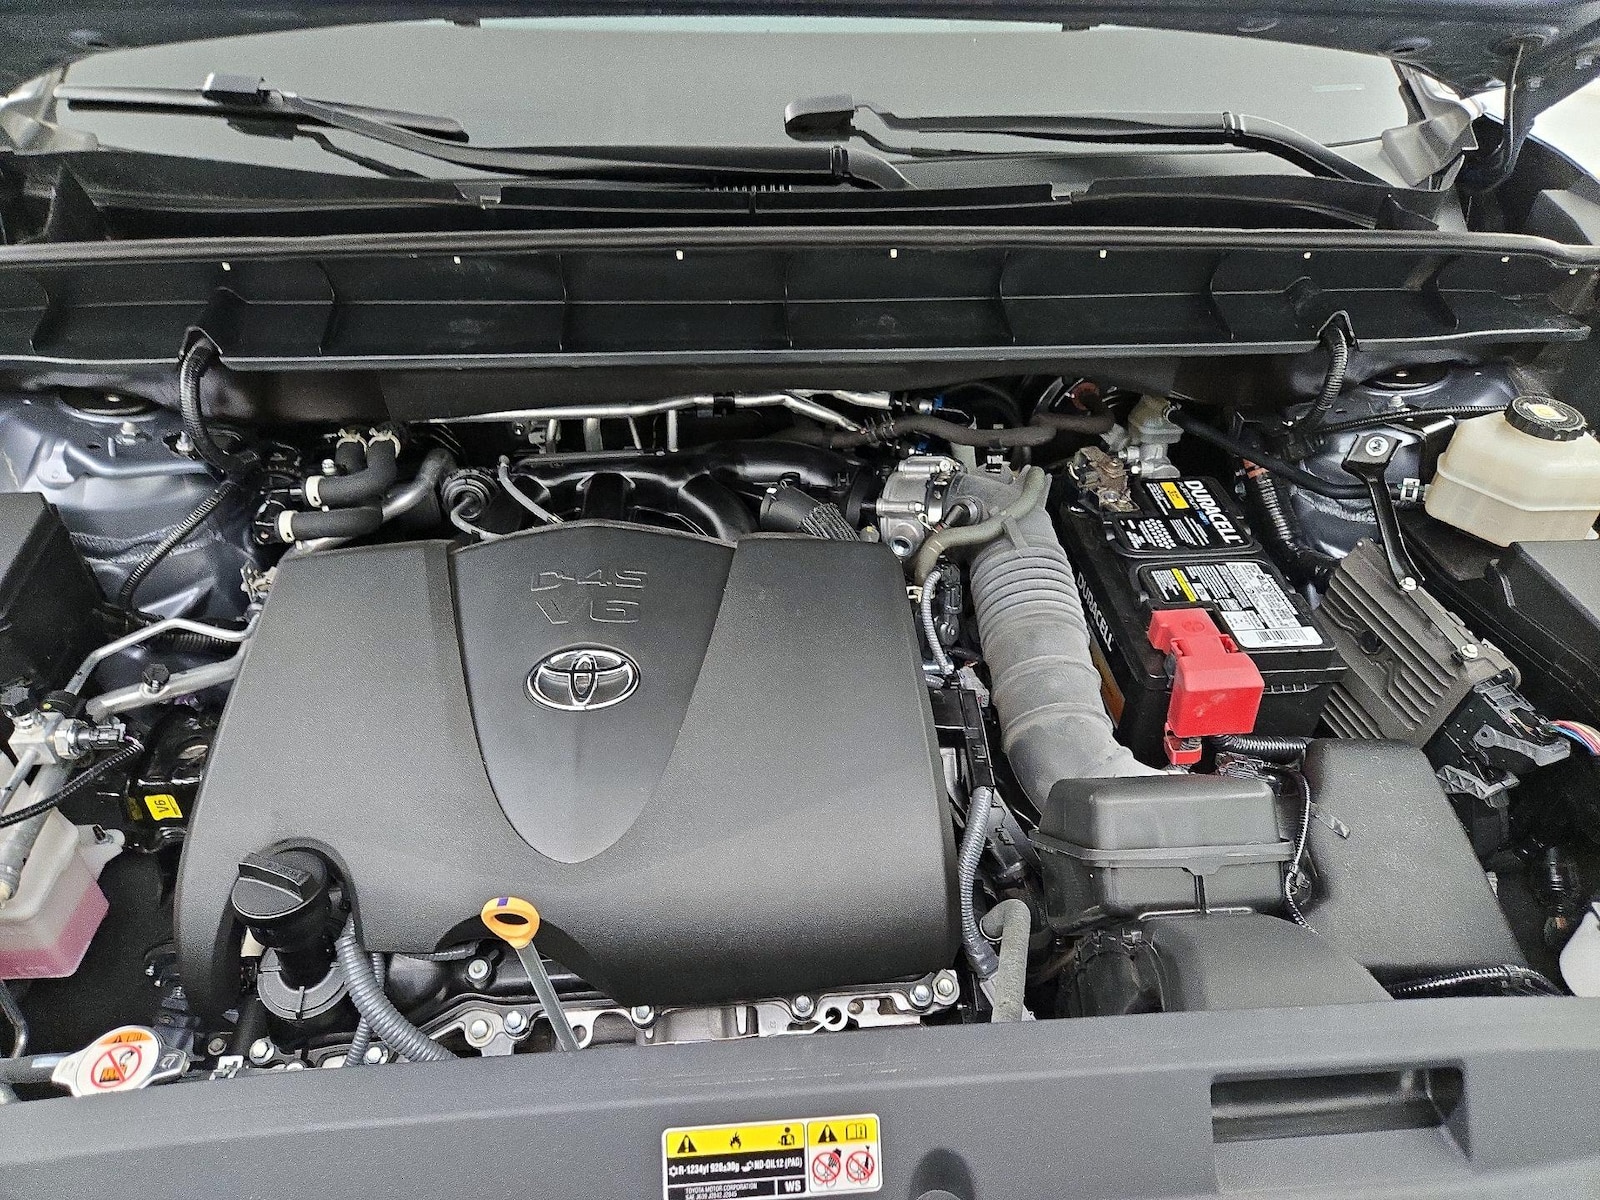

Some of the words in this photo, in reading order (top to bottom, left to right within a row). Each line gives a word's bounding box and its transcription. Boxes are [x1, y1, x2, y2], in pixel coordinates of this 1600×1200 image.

[1183, 480, 1242, 544] DURACELL
[530, 568, 648, 592] D-4S
[534, 599, 640, 625] V6
[1077, 571, 1113, 652] DURACELL
[154, 799, 170, 813] V6
[685, 1186, 705, 1195] TOYOTA
[705, 1184, 723, 1193] MOTOR
[723, 1182, 758, 1191] CORPORATION
[784, 1179, 802, 1193] WS
